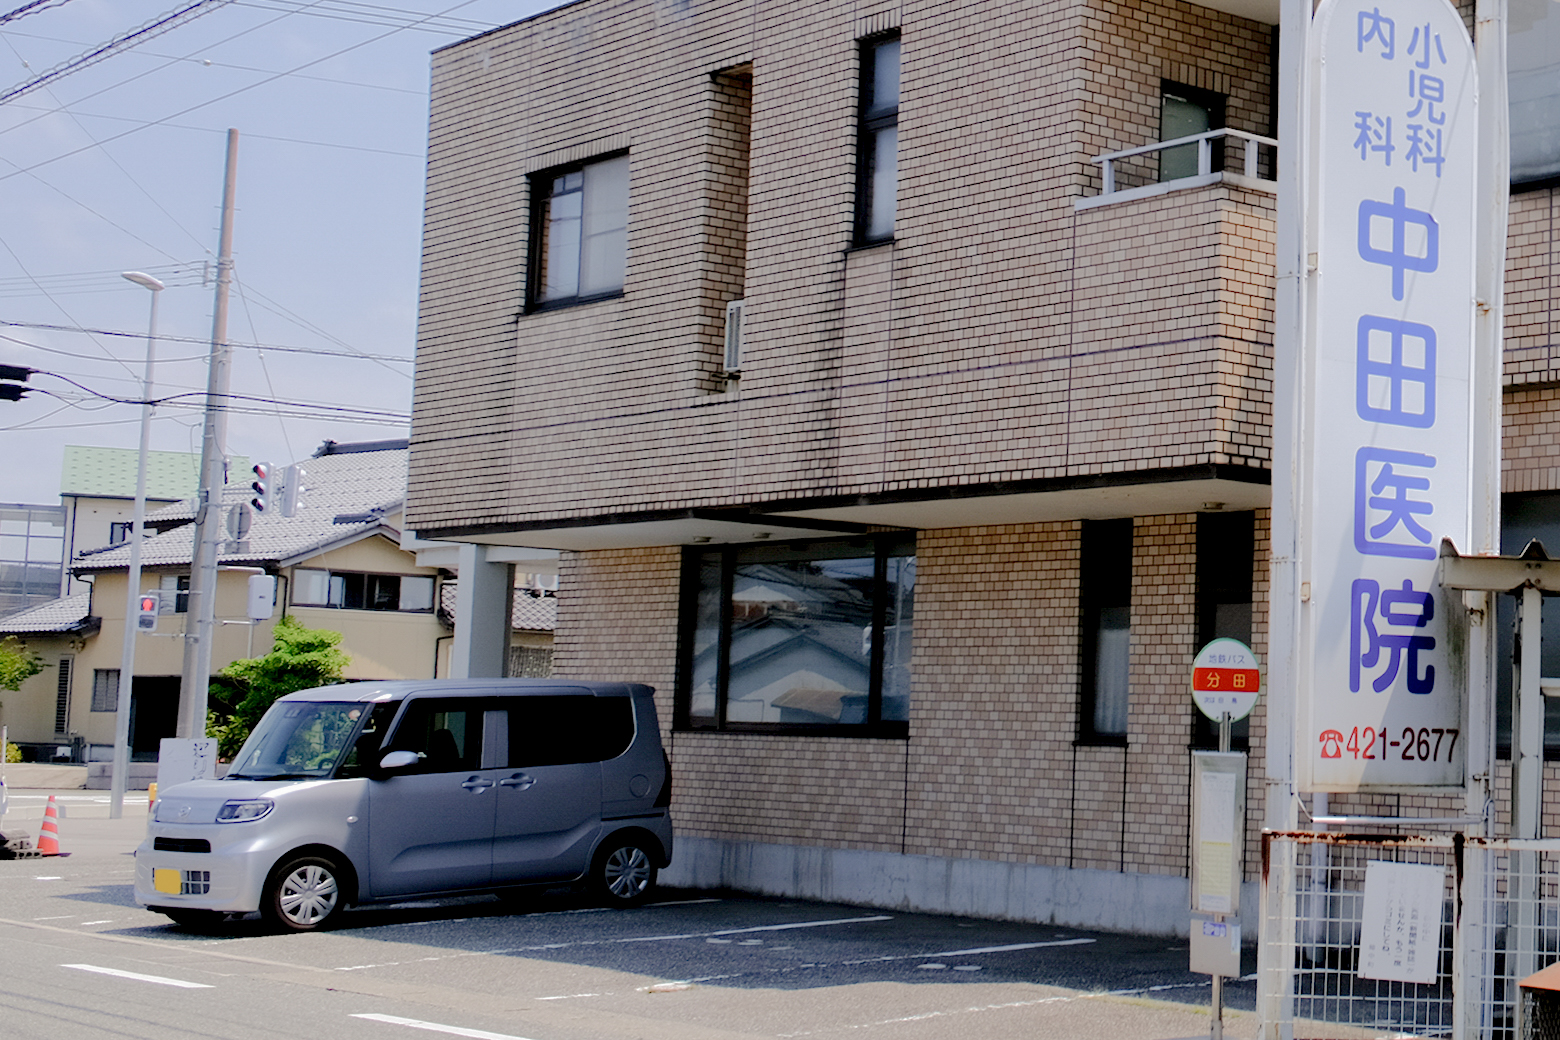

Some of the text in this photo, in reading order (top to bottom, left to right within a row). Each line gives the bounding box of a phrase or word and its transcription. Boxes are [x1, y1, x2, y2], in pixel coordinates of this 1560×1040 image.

[1354, 7, 1396, 167] 内科
[1405, 22, 1448, 178] 小児科
[1349, 186, 1439, 695] 中田医院
[1206, 672, 1246, 689] 分田
[1208, 654, 1245, 665] 地鉄バス
[1346, 726, 1460, 762] 421-2677
